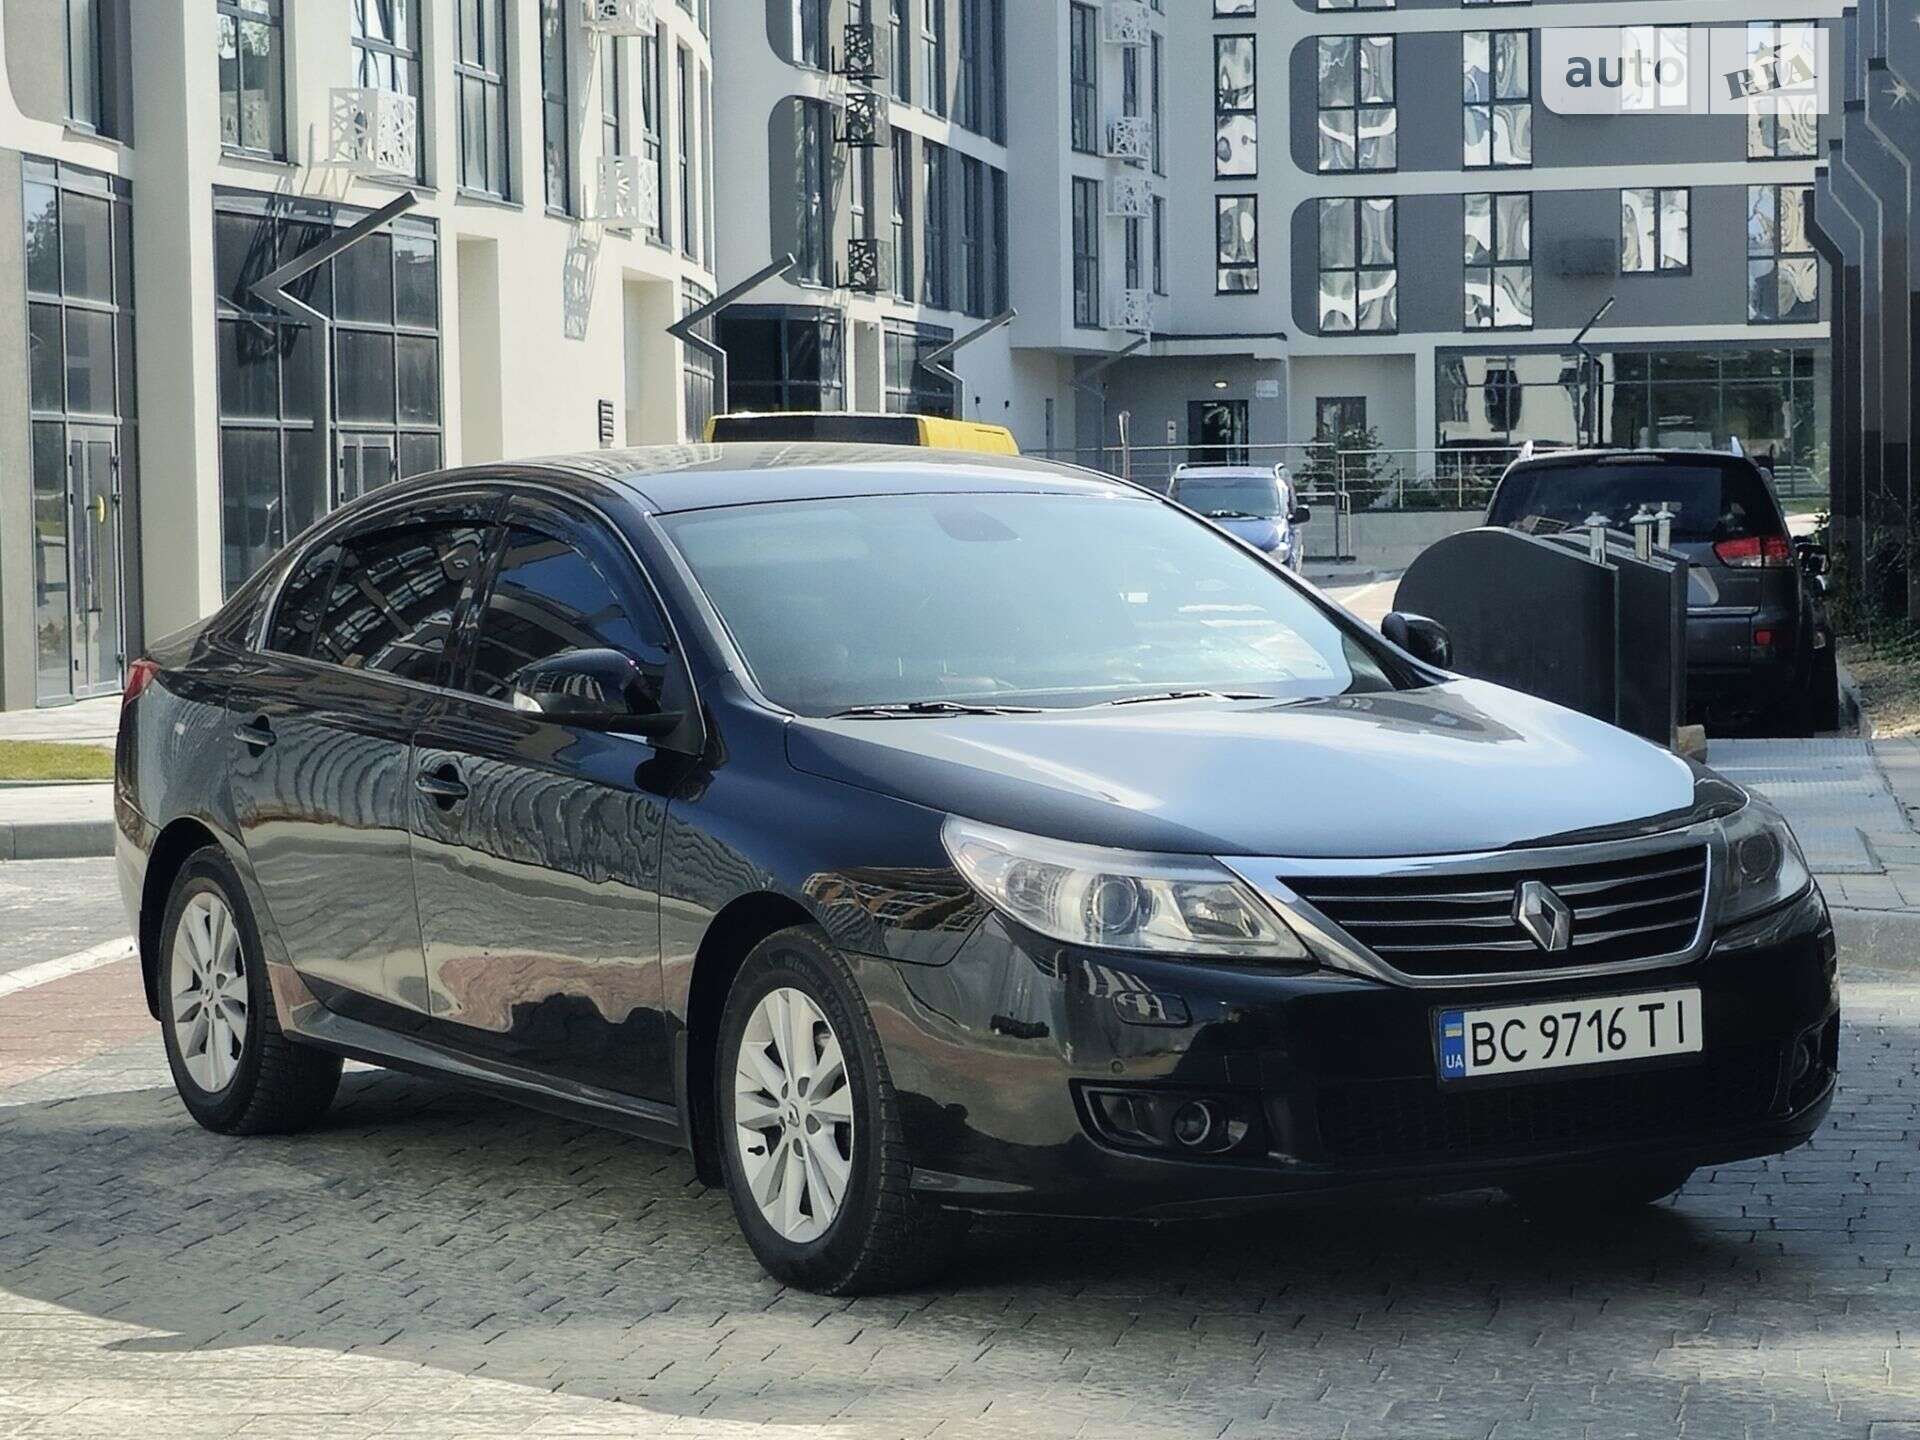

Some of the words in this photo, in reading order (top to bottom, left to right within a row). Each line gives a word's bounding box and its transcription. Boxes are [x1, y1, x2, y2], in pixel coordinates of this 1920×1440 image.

[1471, 1019, 1527, 1067] BC
[1539, 1007, 1627, 1060] 9716
[1638, 1000, 1684, 1048] TI
[1445, 1053, 1464, 1069] UA
